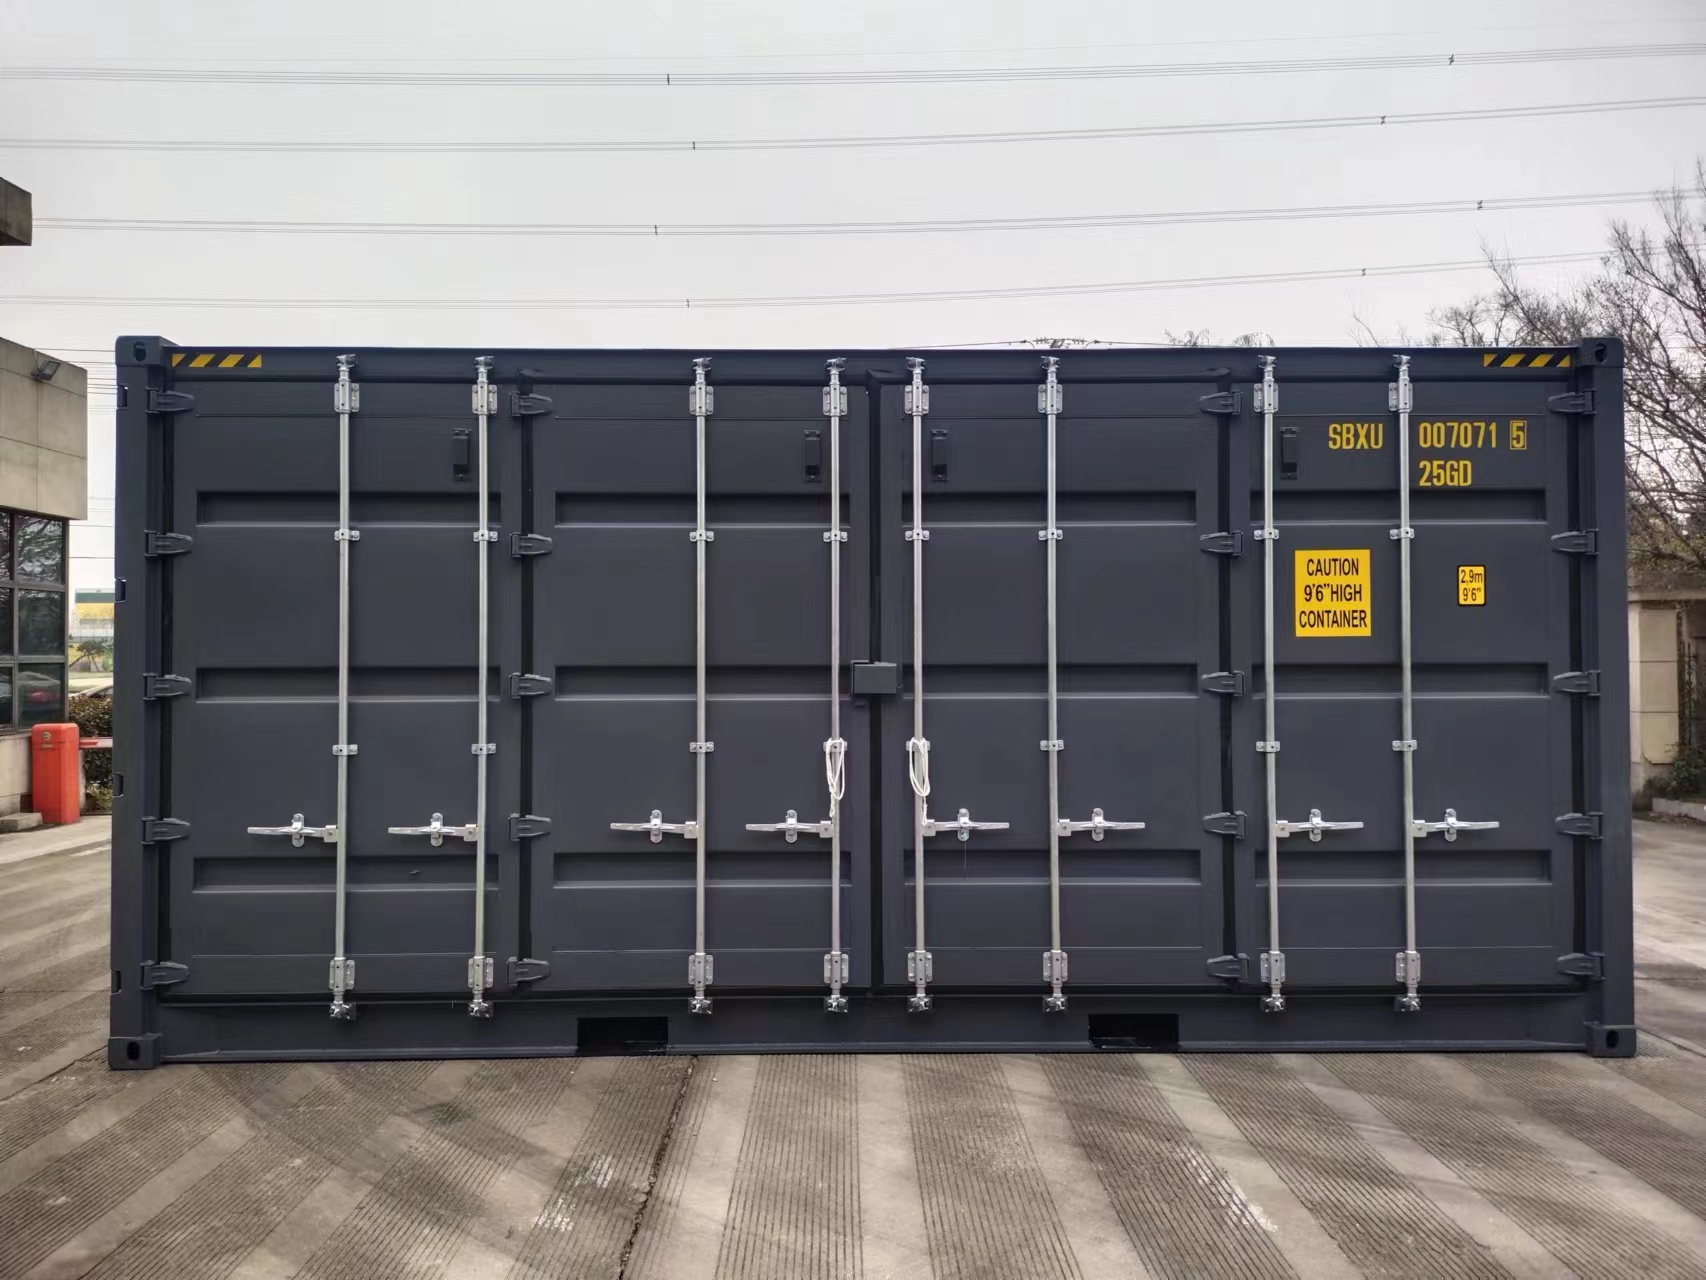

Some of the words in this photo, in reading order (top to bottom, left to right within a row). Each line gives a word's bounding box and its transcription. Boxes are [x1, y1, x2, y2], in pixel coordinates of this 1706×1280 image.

[1328, 423, 1383, 449] SBXU
[1418, 421, 1497, 448] 007071
[1511, 421, 1525, 449] 5
[1418, 459, 1472, 487] 25GD
[1306, 558, 1359, 576] CAUTION
[1299, 609, 1367, 628] CONTAINER
